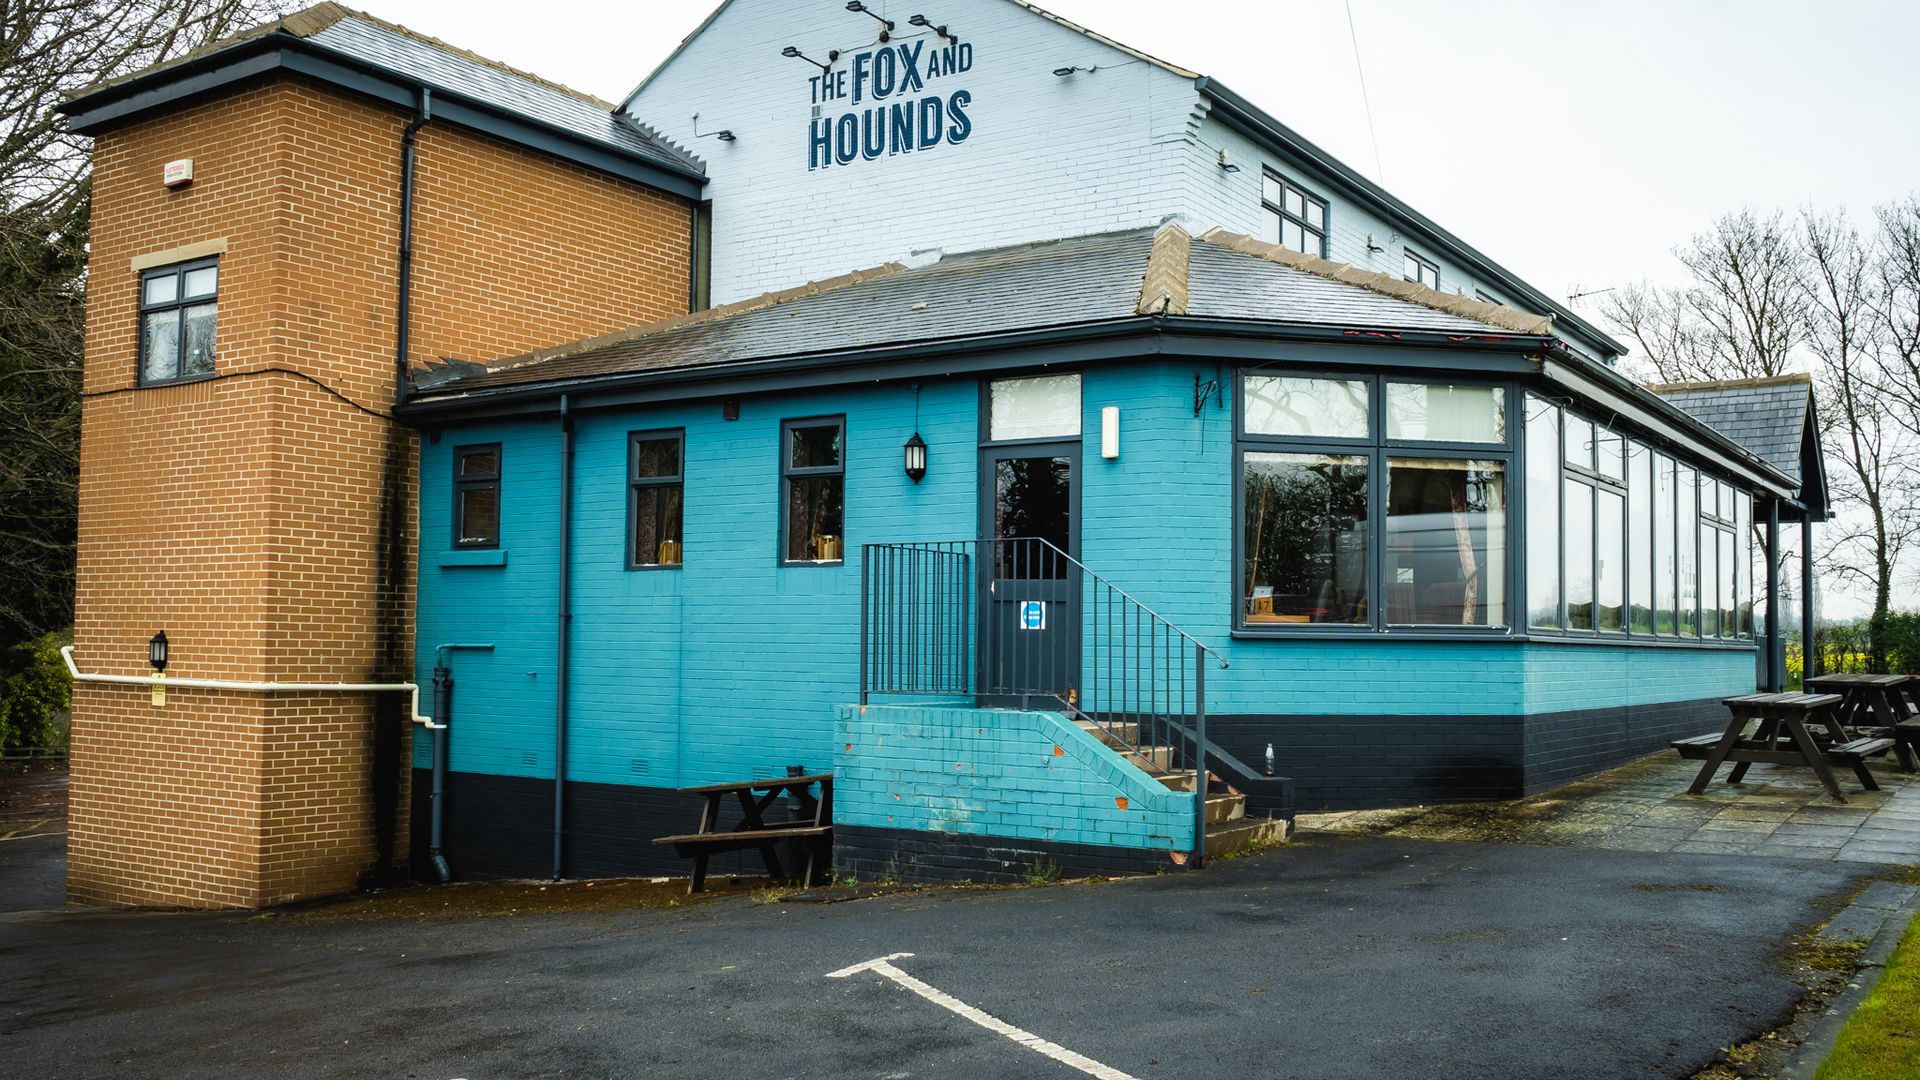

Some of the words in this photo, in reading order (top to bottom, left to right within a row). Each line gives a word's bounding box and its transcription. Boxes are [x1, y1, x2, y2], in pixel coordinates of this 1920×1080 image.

[808, 70, 847, 104] THE
[852, 40, 924, 105] FOX
[927, 42, 973, 80] AND
[808, 90, 972, 171] HOUNDS
[1258, 600, 1270, 611] 17
